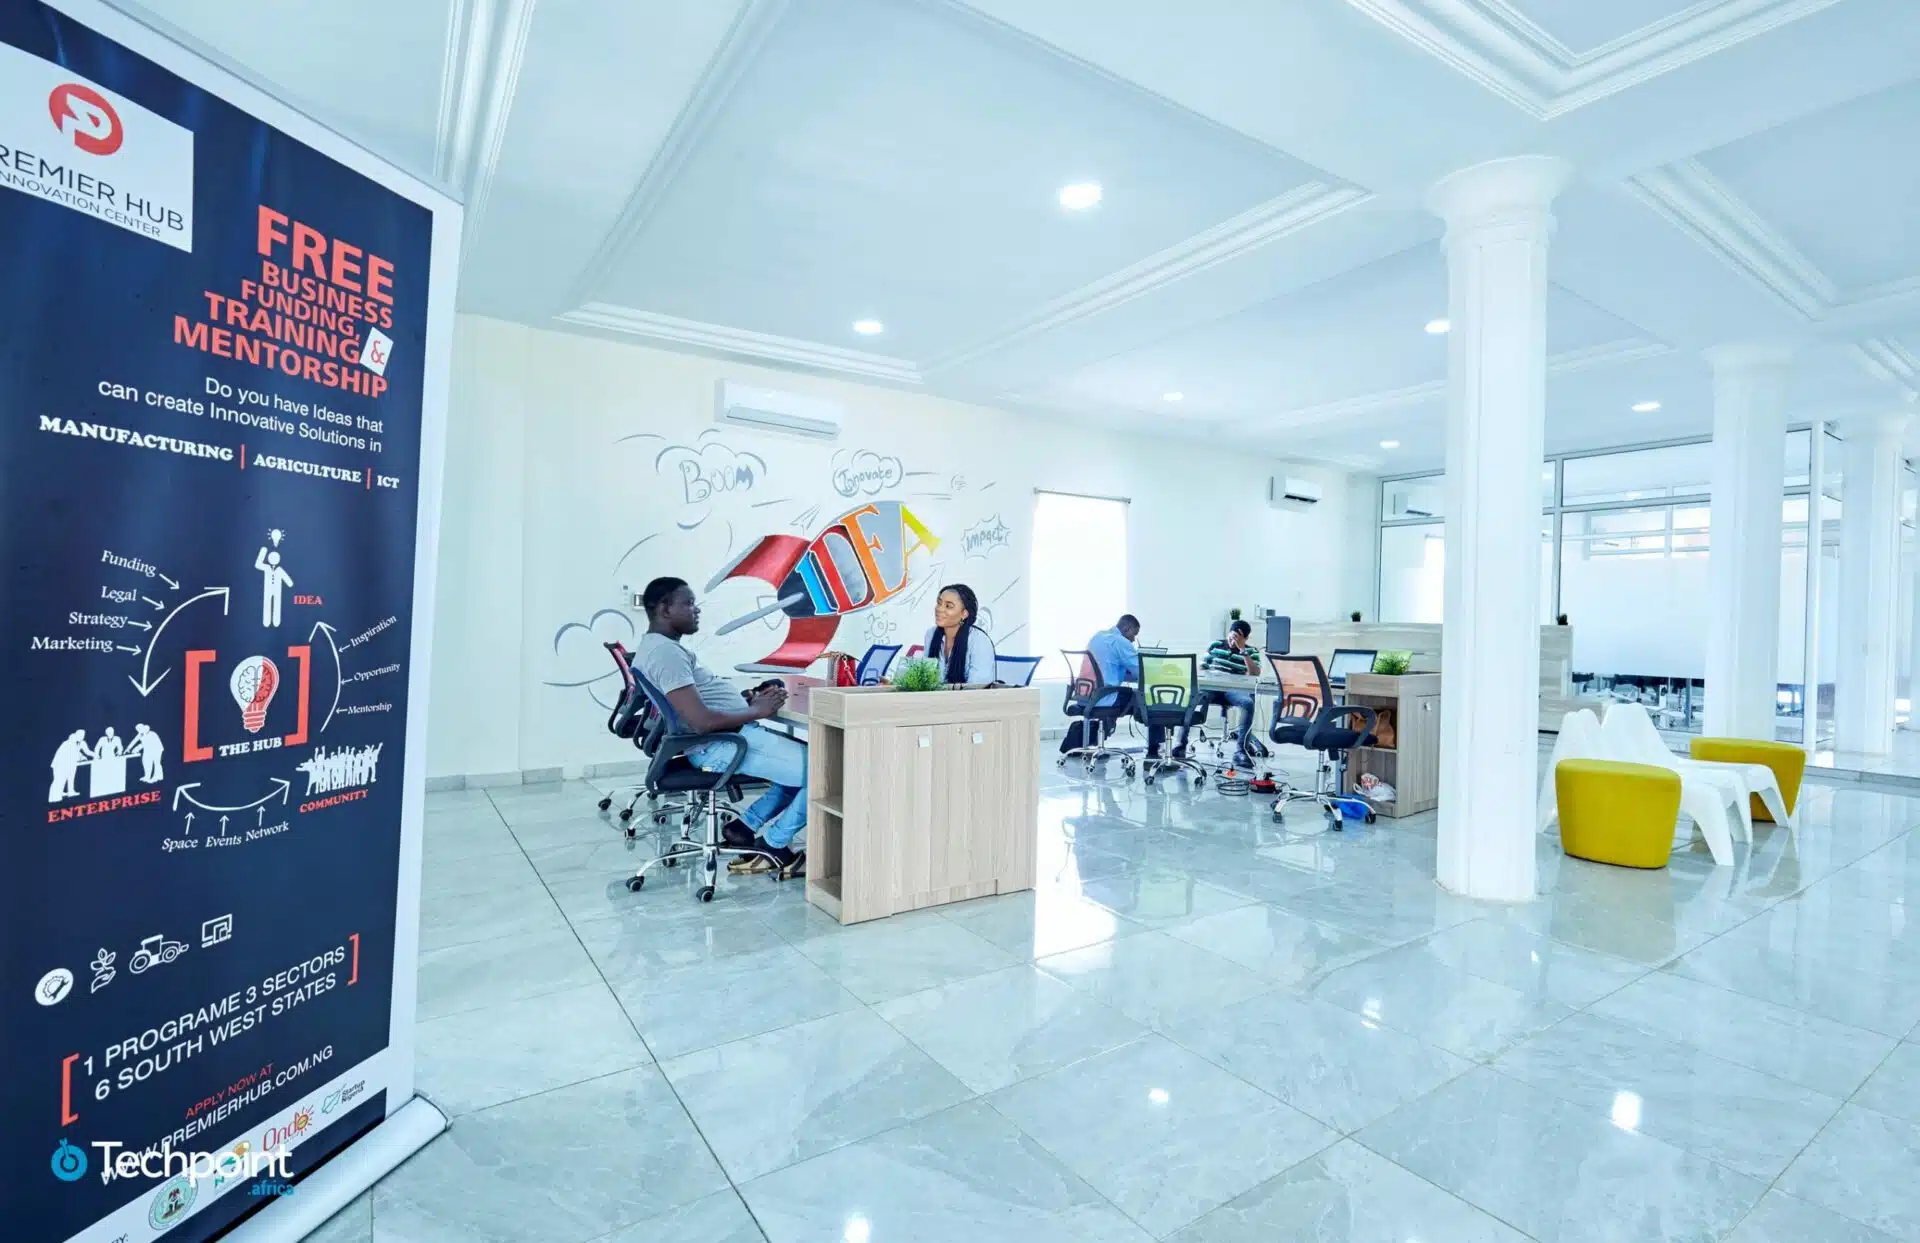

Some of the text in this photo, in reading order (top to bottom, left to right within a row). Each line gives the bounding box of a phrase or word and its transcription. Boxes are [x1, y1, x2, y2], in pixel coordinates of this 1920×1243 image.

[0, 144, 184, 232] REMIER HUB
[0, 170, 161, 238] NNOVATION CENTER
[257, 204, 395, 306] FREE
[262, 259, 393, 329] BUSINESS
[204, 290, 361, 365] TRAINING
[174, 315, 388, 399] MENTORSHIP
[98, 380, 382, 453] can create Innovative Solutions in
[205, 376, 383, 433] Do you have Ideas that
[39, 415, 400, 489] MANUFACTURING AGRICULTURE ICT
[101, 550, 157, 578] Funding
[794, 503, 943, 616] IDEA
[68, 611, 129, 629] Strategy
[101, 586, 137, 603] Legal
[293, 595, 323, 606] IDEA
[31, 636, 114, 653] Marketing
[350, 615, 398, 648] Inspiration
[353, 662, 401, 682] Opportunity
[347, 702, 393, 716] Mentorship
[219, 736, 283, 757] THE HUB
[48, 791, 161, 824] ENTERPRISE
[300, 789, 369, 814] COMMUNITY
[161, 820, 289, 852] Space Events Network
[84, 946, 345, 1077] 1 PROGRAME 3 SECTORS
[95, 972, 337, 1100] 6 SOUTH WEST STATES
[185, 1063, 275, 1120] APPLY NOW AT
